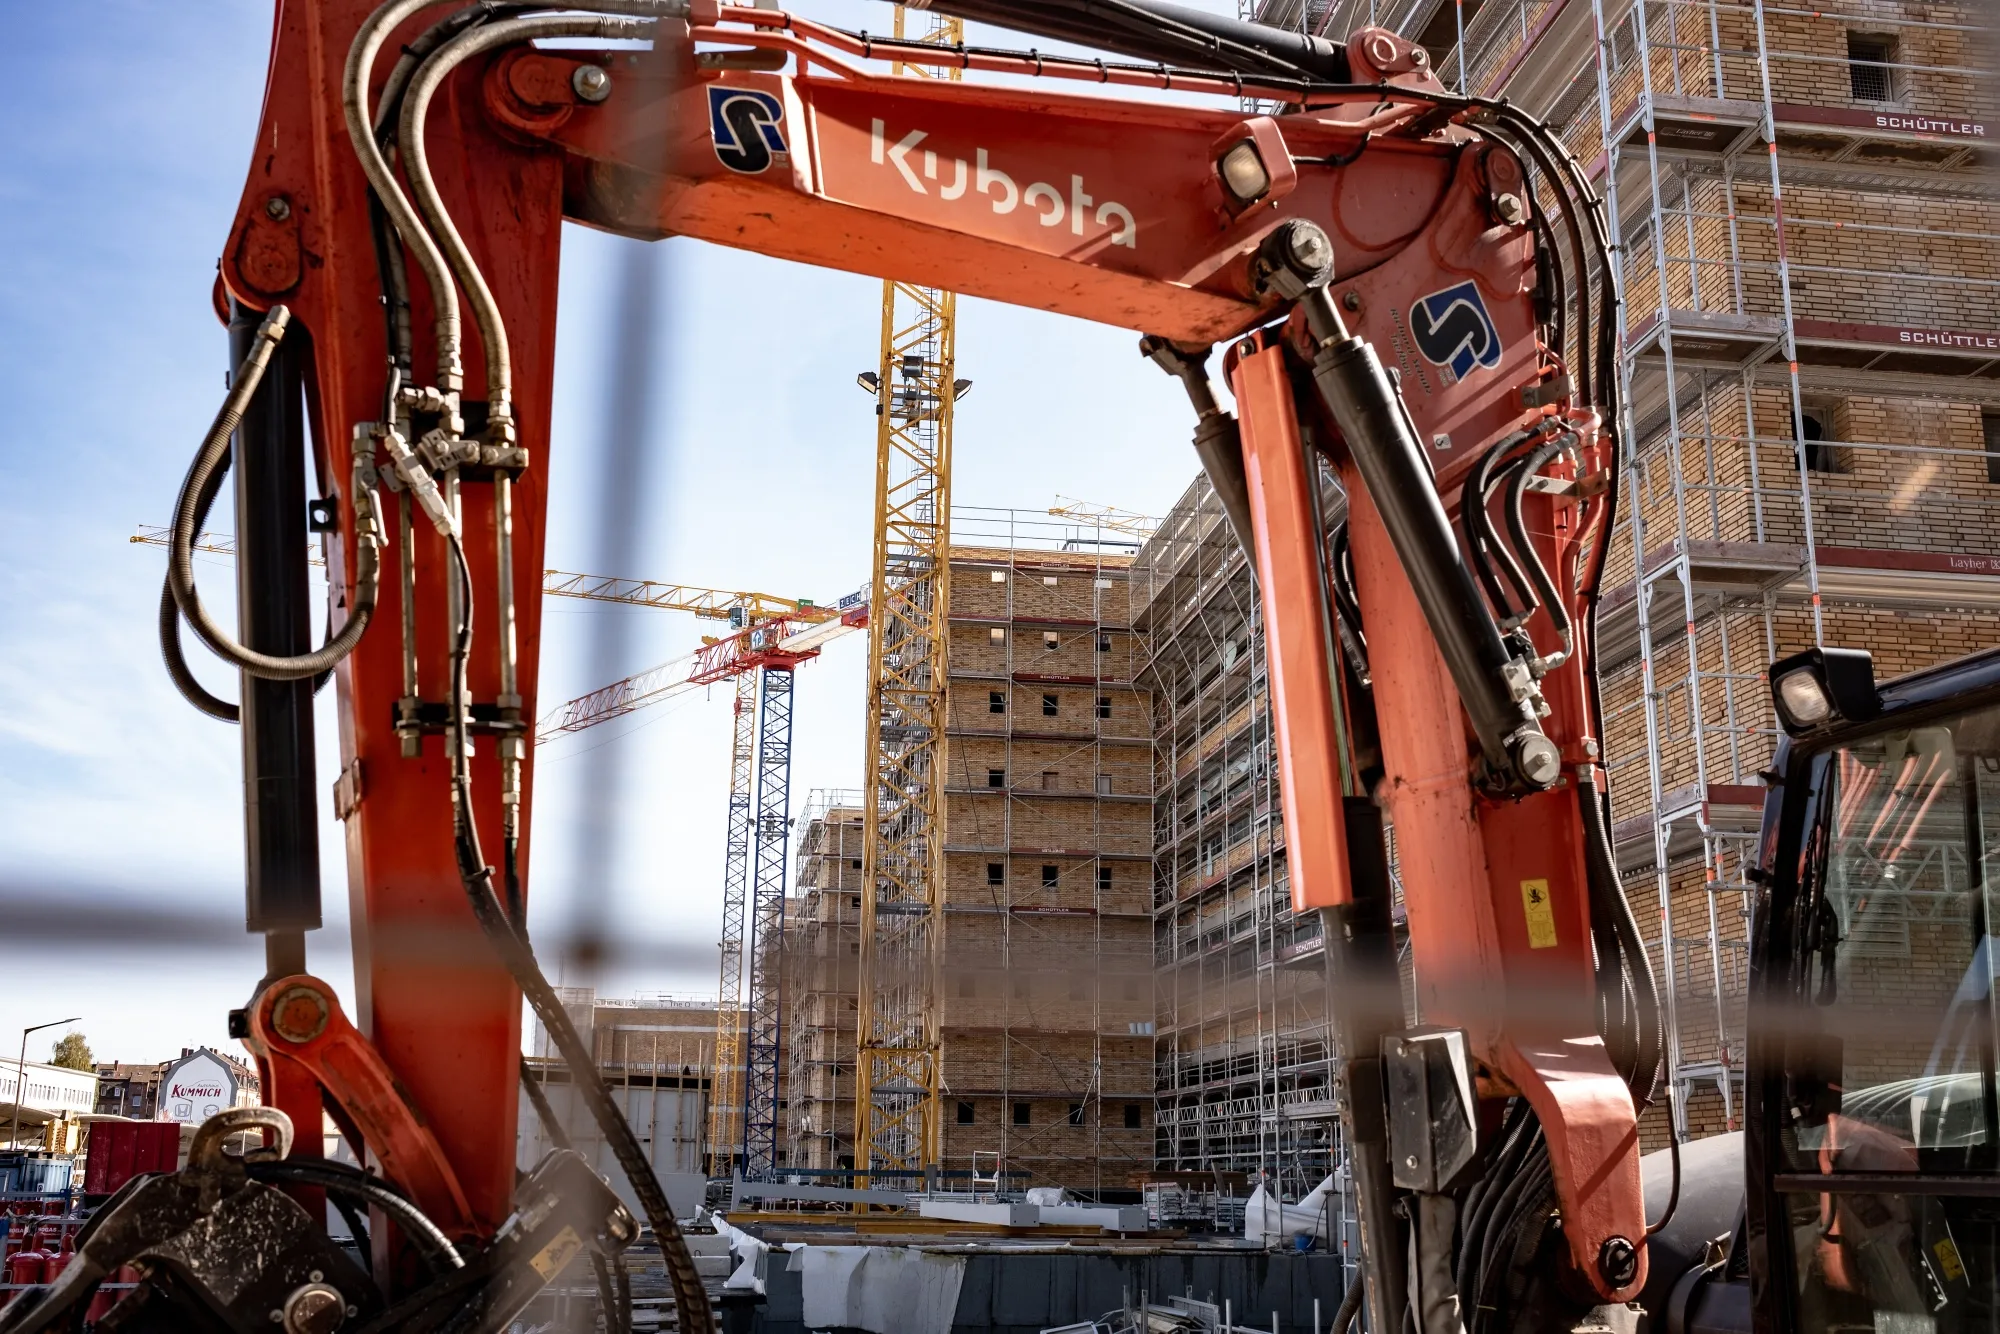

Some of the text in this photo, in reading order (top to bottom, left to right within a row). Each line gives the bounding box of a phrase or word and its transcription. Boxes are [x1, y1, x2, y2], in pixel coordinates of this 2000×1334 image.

[1876, 116, 1984, 136] SCHÜTTLER
[871, 117, 1136, 249] Kubota
[1900, 331, 2000, 348] SCHÜTTLE
[1950, 557, 1987, 571] Layher
[840, 592, 861, 609] ZECH
[1296, 938, 1322, 953] SCHÜTTLER
[171, 1084, 222, 1098] KUMMICH
